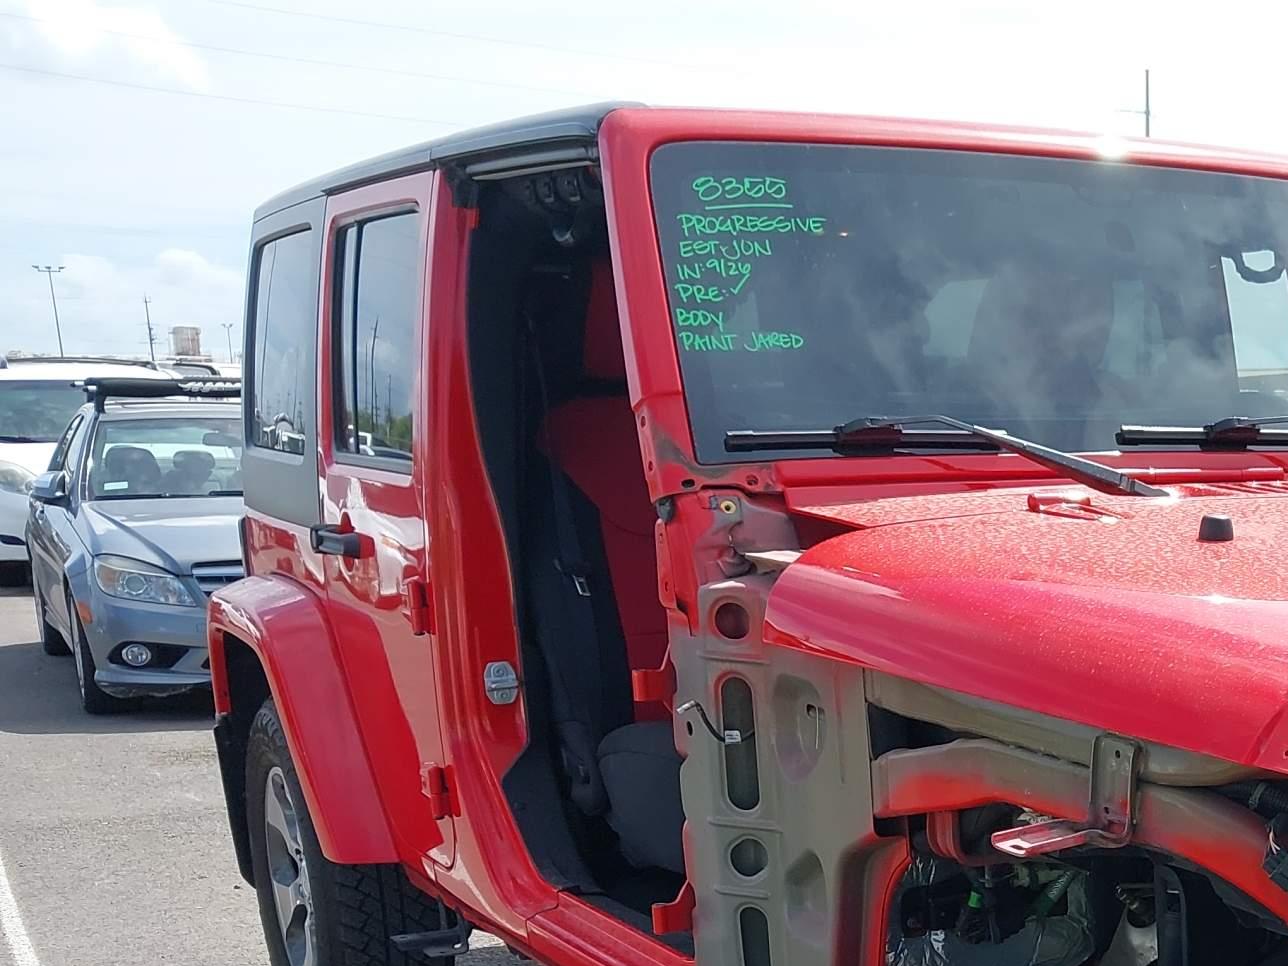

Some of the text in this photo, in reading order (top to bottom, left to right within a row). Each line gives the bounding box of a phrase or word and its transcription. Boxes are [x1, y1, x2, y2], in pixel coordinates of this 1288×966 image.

[692, 176, 786, 201] 8355
[676, 213, 827, 237] PROGRESSIVE
[705, 258, 751, 278] 9/26
[674, 283, 729, 303] PRE:
[676, 308, 724, 332] BODY
[678, 331, 804, 352] PAINT JARED
